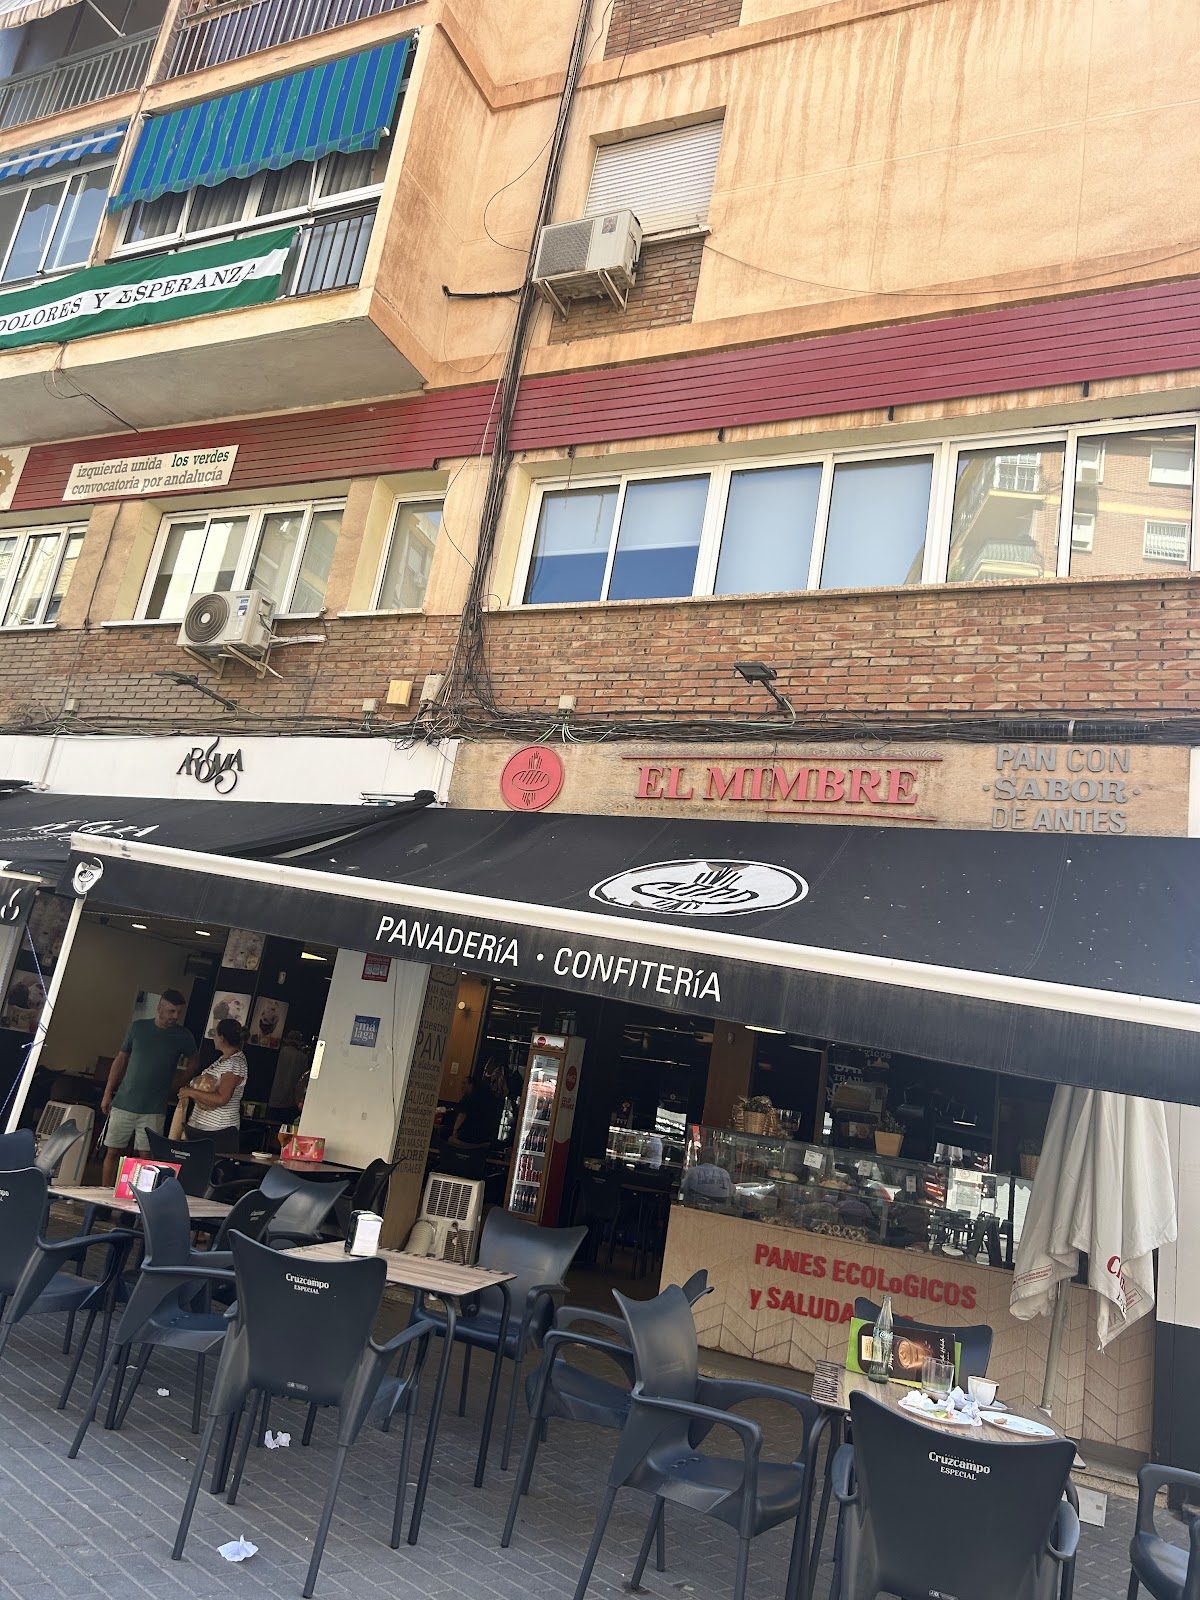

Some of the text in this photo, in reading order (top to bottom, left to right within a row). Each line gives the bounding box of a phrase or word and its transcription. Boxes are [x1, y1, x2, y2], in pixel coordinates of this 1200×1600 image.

[94, 292, 110, 309] Y
[116, 263, 257, 304] ESPERANZA
[77, 449, 229, 479] izquierda unida los verdes
[71, 466, 223, 495] convocatoria por andalucía
[176, 736, 244, 795] AROMA
[995, 748, 1131, 773] PAN CON
[634, 766, 919, 805] EL MIMBRE
[994, 777, 1127, 803] SABOR
[991, 806, 1127, 834] DE ANTES
[754, 1243, 827, 1279] PANES
[285, 1273, 330, 1289] Cruzcampo
[293, 1284, 320, 1294] ESPECIAL
[766, 1286, 854, 1324] SALUDA
[928, 1451, 991, 1474] Cruzcampo
[940, 1466, 977, 1480] ESPECIAL
